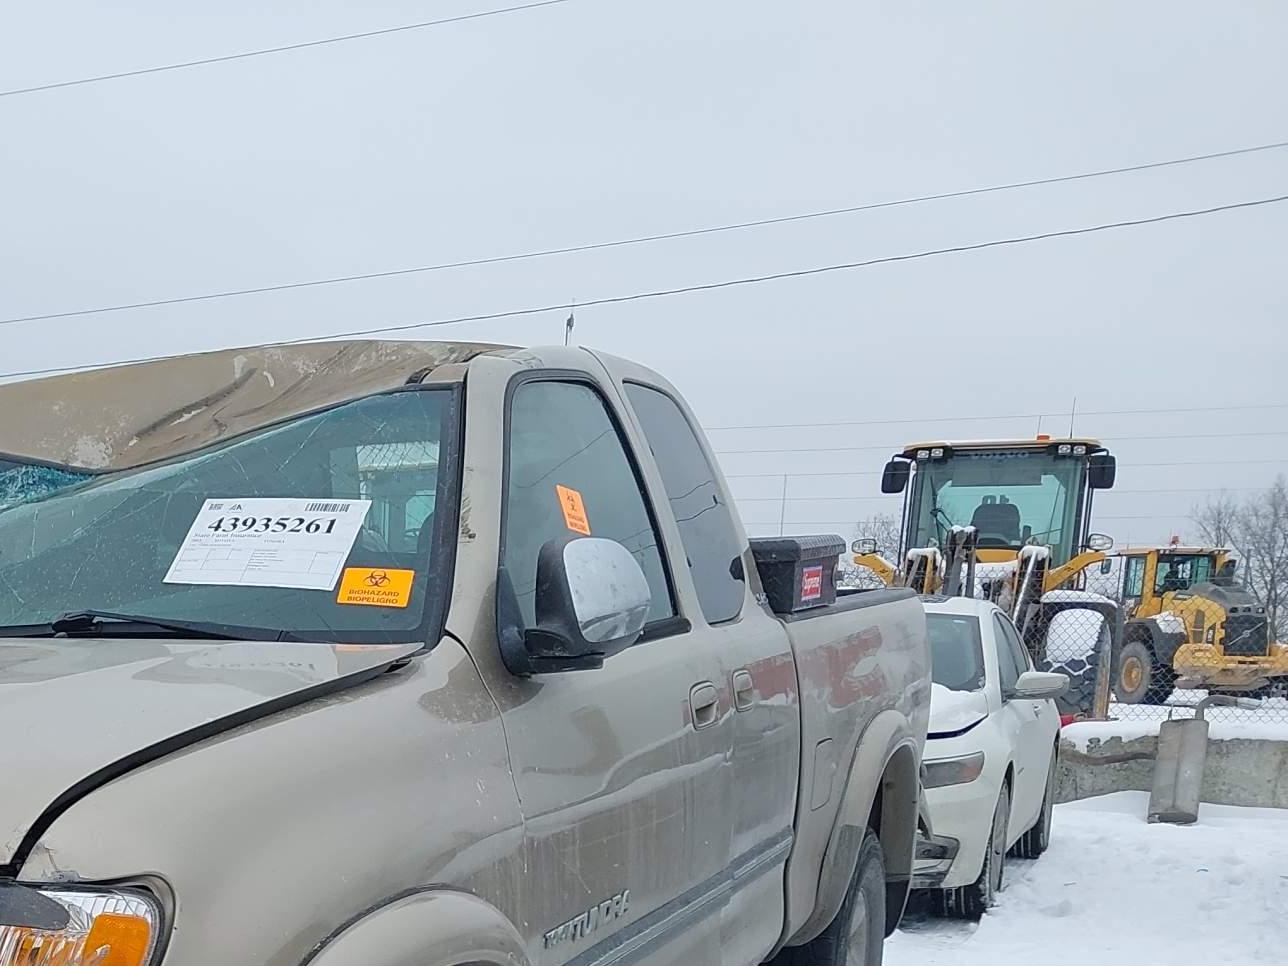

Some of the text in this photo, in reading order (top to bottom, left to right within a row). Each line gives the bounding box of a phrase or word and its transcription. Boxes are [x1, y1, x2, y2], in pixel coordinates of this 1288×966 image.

[207, 516, 338, 534] 43935261
[348, 588, 400, 597] BIOHAZARD
[346, 595, 399, 604] BIOPELIGRO
